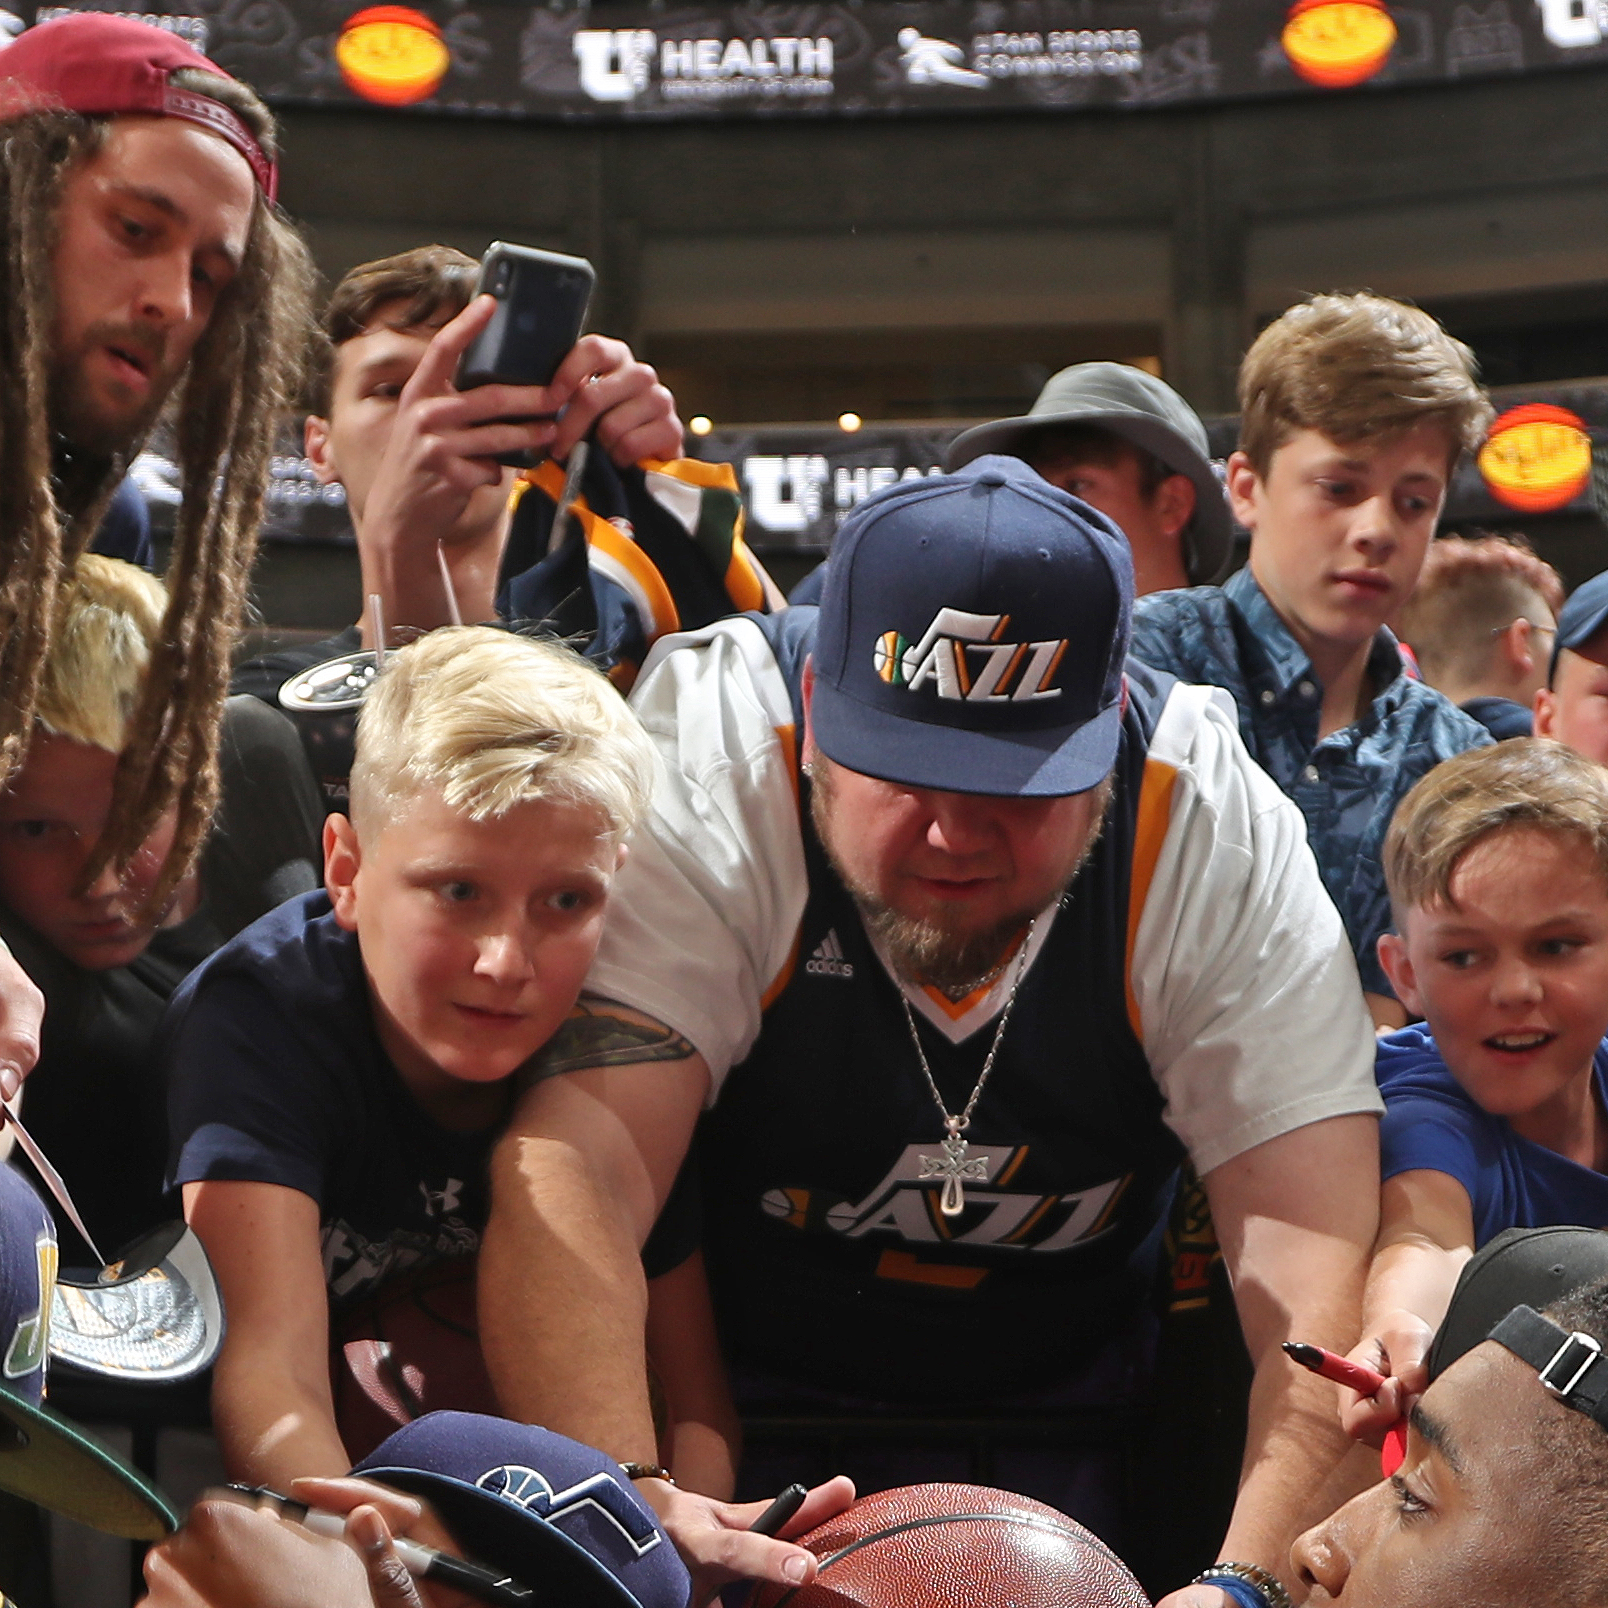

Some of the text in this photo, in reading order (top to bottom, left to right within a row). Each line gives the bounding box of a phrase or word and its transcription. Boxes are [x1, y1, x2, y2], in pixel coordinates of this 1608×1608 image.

[660, 37, 834, 77] HEALTH
[874, 606, 1070, 702] JAZZ
[805, 959, 854, 977] adidas
